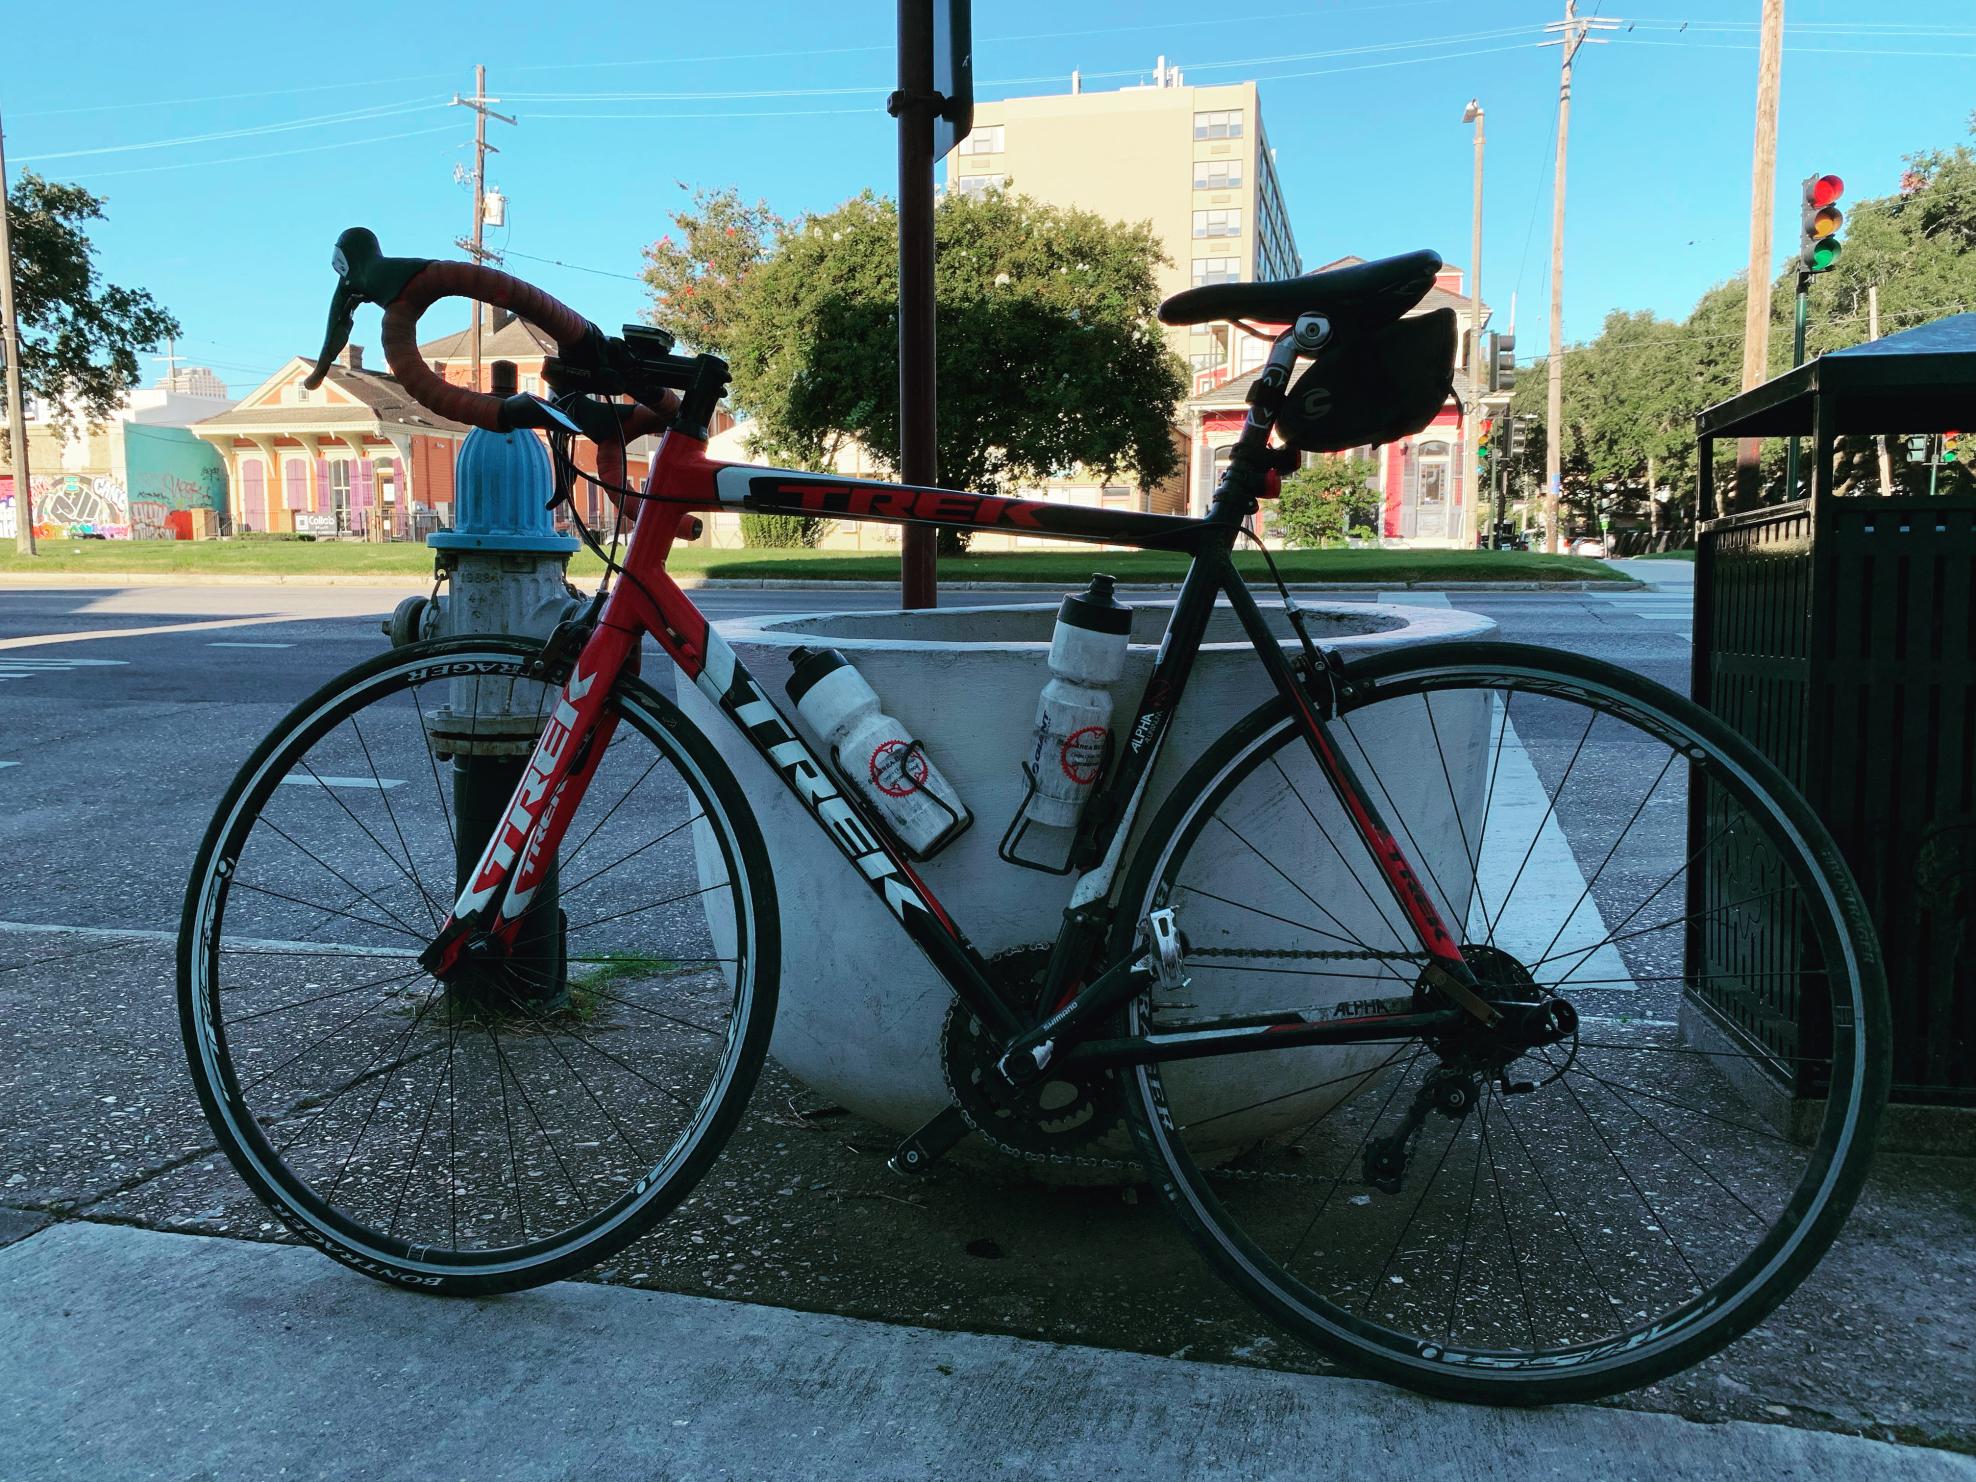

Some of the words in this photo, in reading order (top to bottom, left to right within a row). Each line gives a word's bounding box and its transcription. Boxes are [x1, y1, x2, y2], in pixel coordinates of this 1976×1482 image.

[777, 484, 1055, 528] TREK
[483, 661, 597, 875] TREK
[1131, 711, 1155, 754] ALPHA
[522, 779, 568, 877] TREK
[733, 680, 930, 920] TREK
[272, 1203, 446, 1286] BONTRAGER
